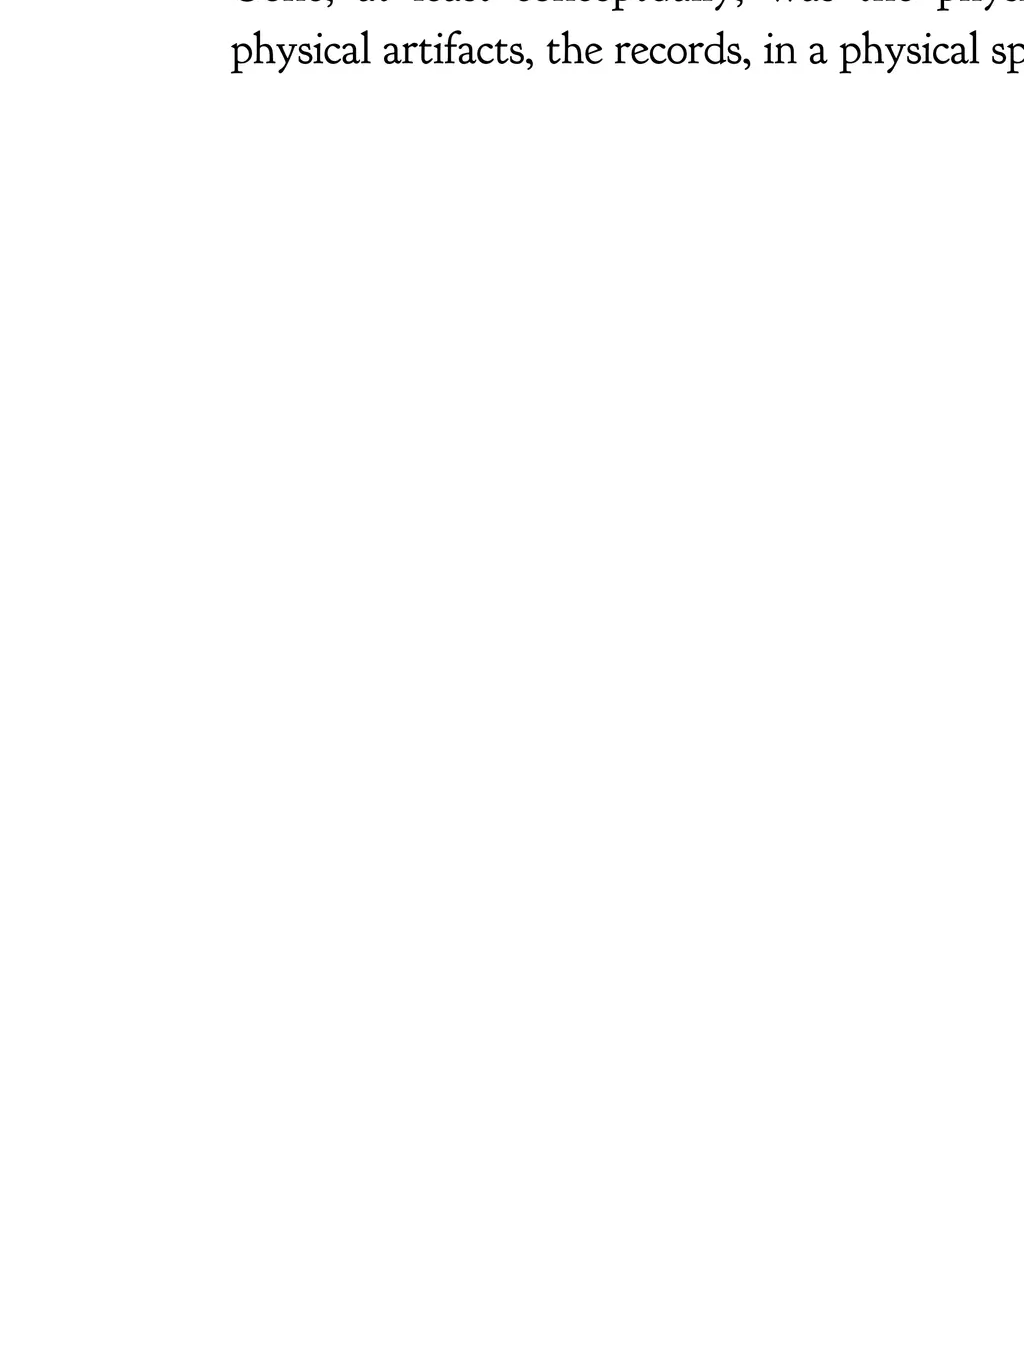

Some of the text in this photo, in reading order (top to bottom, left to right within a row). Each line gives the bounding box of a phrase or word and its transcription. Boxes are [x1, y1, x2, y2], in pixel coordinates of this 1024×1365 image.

[231, 30, 371, 73] physical
[384, 30, 533, 70] artifacts,
[547, 30, 603, 64] the
[615, 31, 750, 70] records,
[764, 33, 797, 63] in
[810, 43, 827, 64] a
[840, 30, 979, 74] physical
